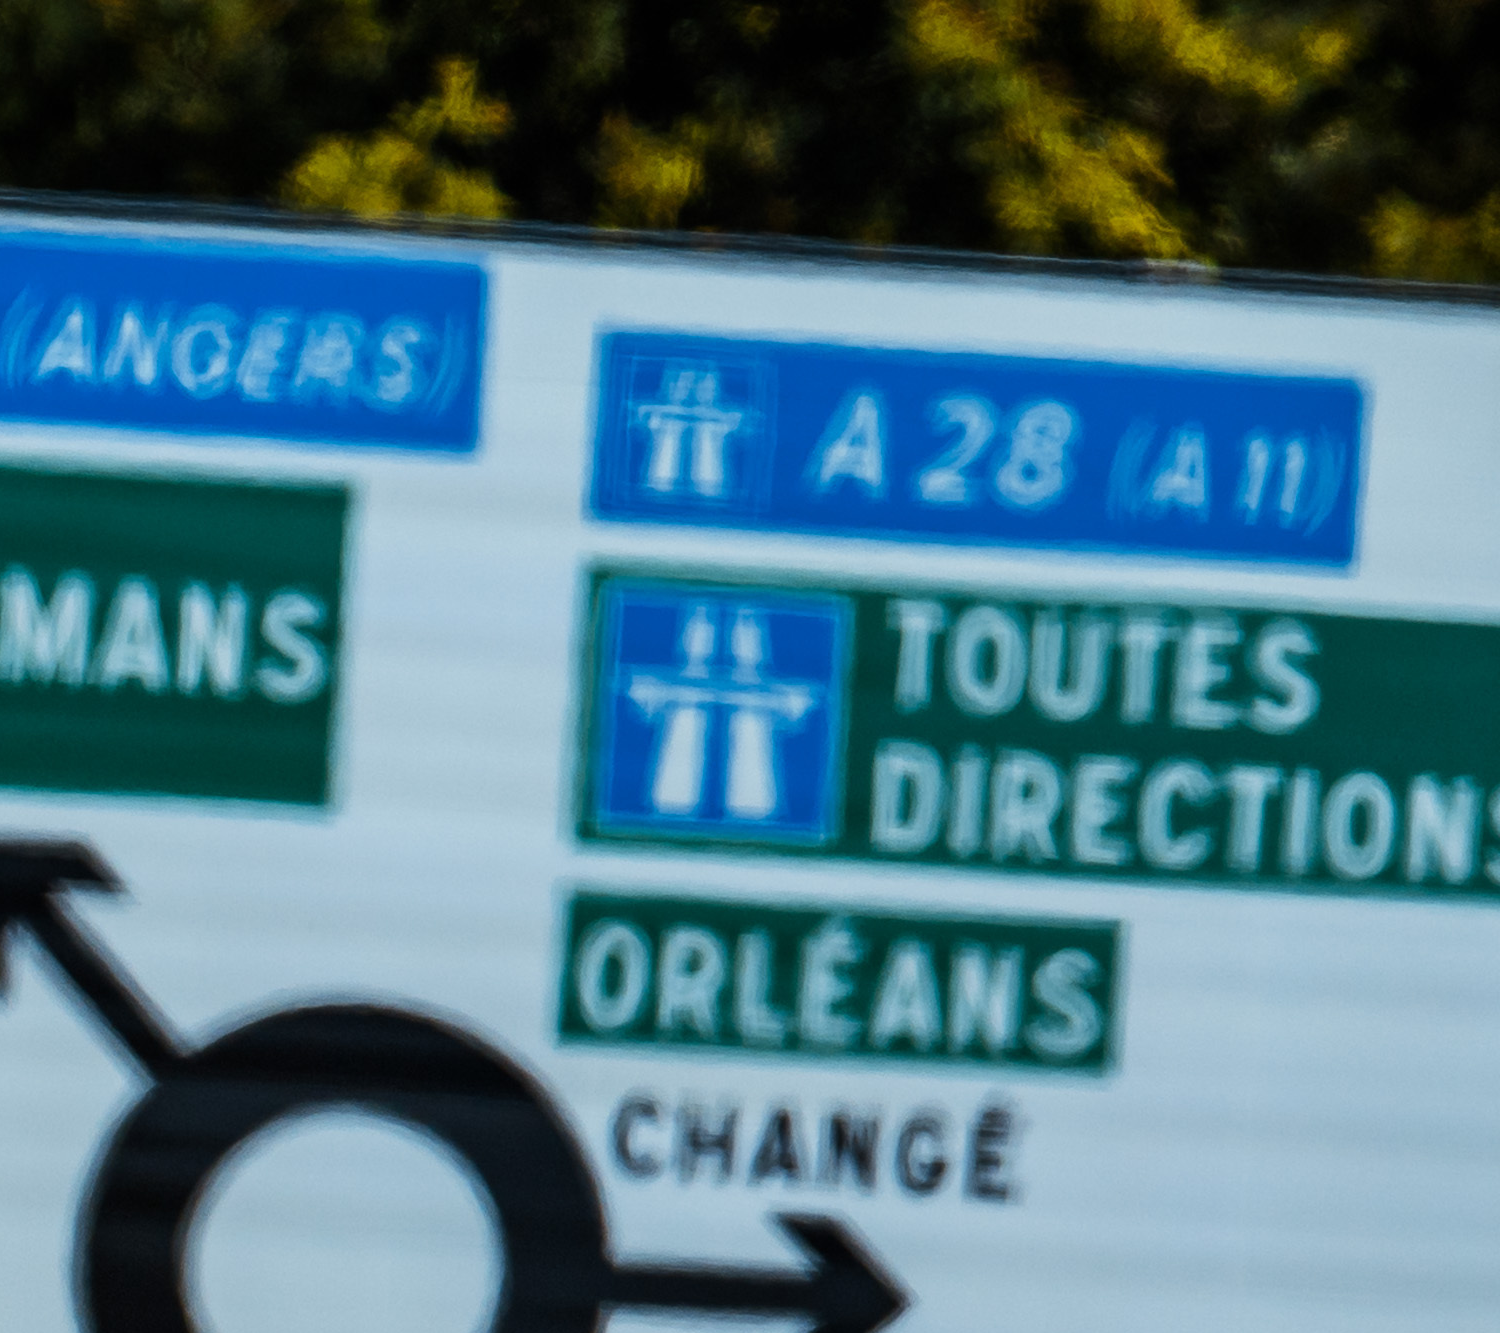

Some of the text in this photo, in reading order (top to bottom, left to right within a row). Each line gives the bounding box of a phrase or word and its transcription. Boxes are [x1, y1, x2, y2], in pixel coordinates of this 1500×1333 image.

[812, 393, 888, 502] A
[916, 393, 1080, 512] 28
[886, 596, 1324, 736] TOUTES
[575, 912, 1102, 1062] ORLÉANS
[610, 1094, 1024, 1202] CHANGÉ
